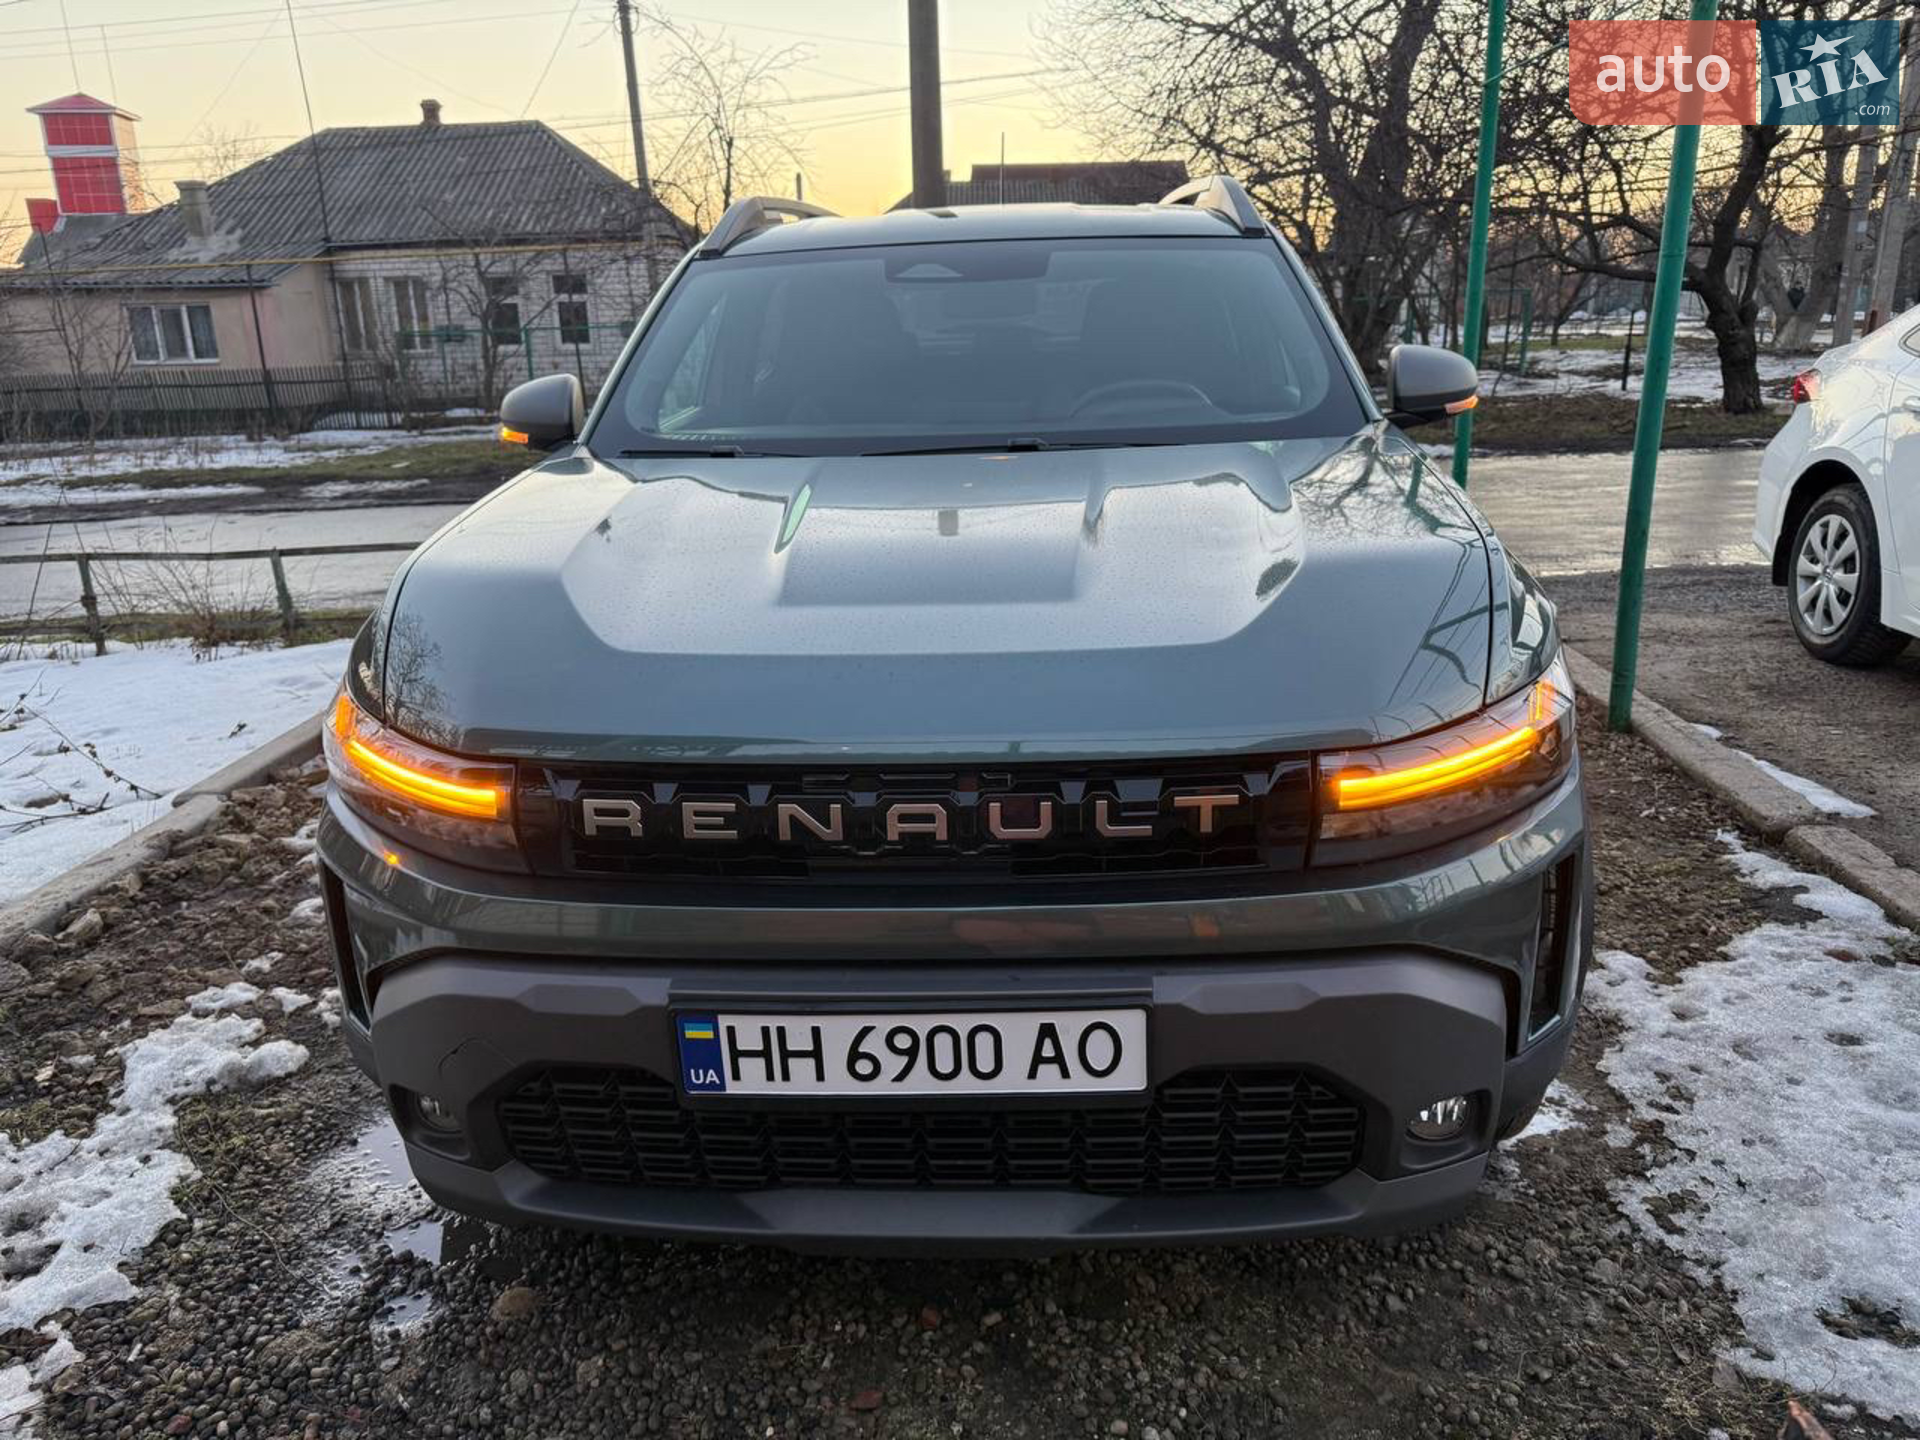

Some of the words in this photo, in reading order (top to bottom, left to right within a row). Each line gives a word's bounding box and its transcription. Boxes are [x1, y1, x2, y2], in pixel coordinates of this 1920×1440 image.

[582, 794, 1240, 841] RENAULT
[725, 1025, 826, 1082] HH
[846, 1023, 1004, 1082] 6900
[1027, 1020, 1123, 1080] AO
[690, 1068, 720, 1085] UA
